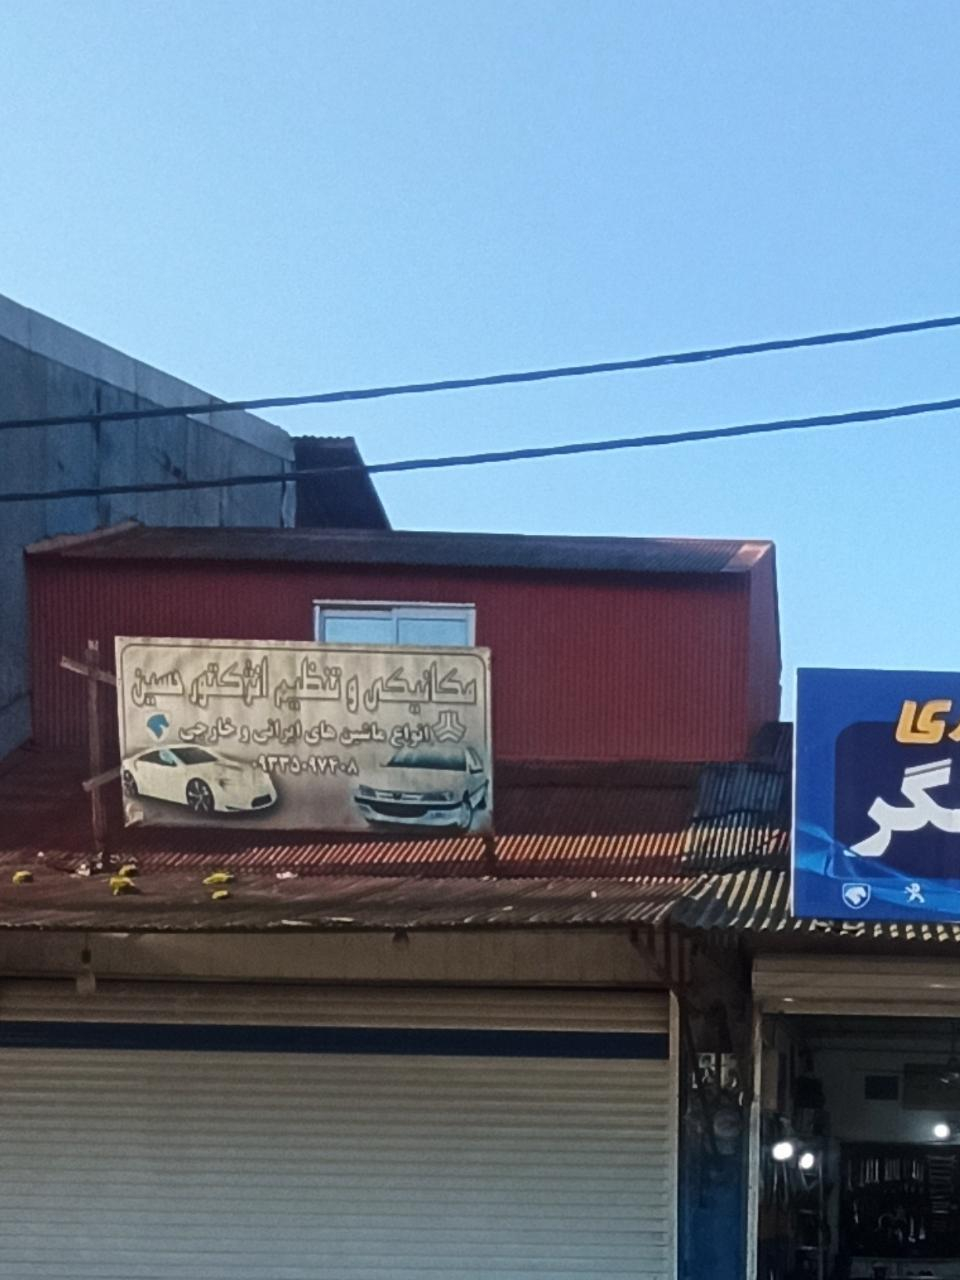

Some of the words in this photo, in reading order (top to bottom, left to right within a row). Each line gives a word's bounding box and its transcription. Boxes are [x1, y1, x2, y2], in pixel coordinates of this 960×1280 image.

[131, 667, 185, 707] حسین
[189, 655, 268, 709] انژکتور
[274, 656, 342, 710] تنظیم
[346, 674, 359, 714] و
[363, 660, 477, 714] مکانیکی
[178, 716, 237, 742] خارجی
[239, 724, 250, 744] و
[252, 718, 302, 745] ایرانی
[304, 719, 337, 745] های
[339, 721, 386, 746] ماشین
[389, 722, 430, 748] انواع
